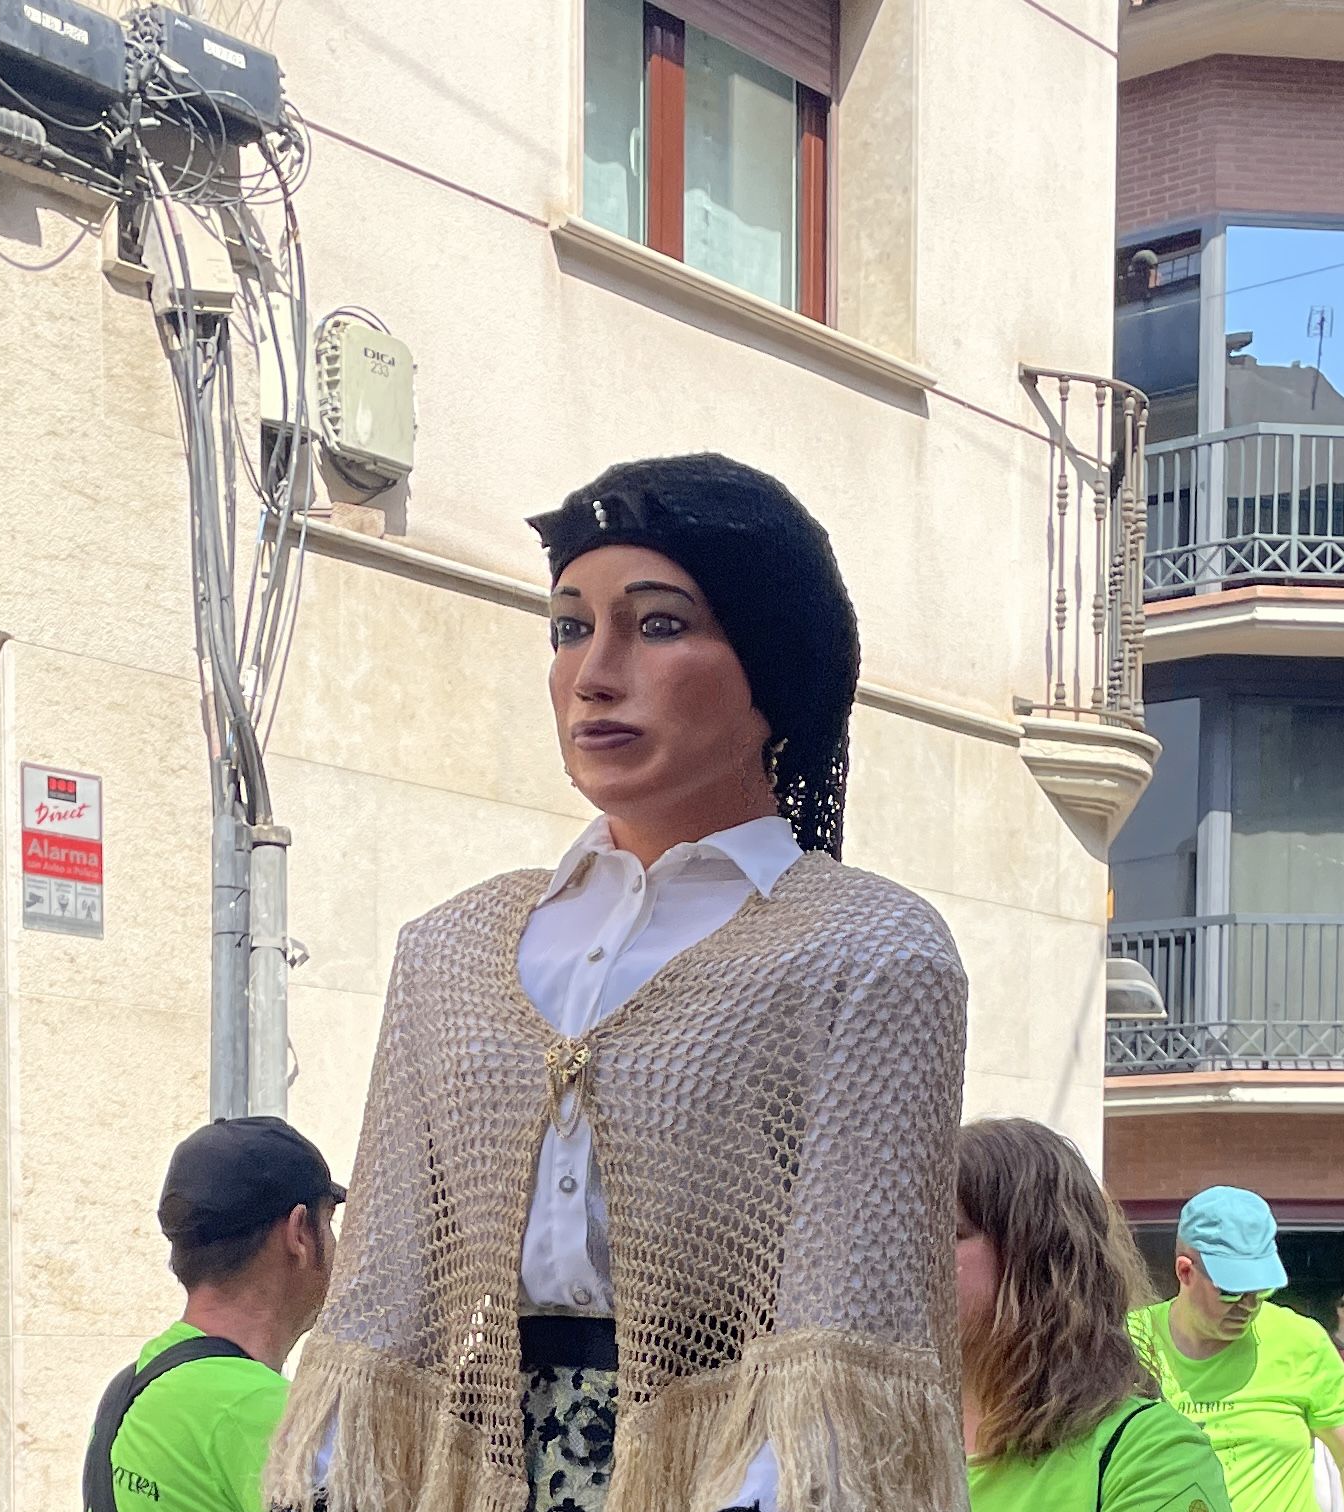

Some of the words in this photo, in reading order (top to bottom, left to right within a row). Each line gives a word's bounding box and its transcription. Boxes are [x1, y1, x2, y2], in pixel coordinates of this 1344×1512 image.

[364, 347, 395, 367] DIGI
[370, 360, 390, 378] 233
[35, 802, 92, 825] Direct
[27, 838, 99, 868] Alarma
